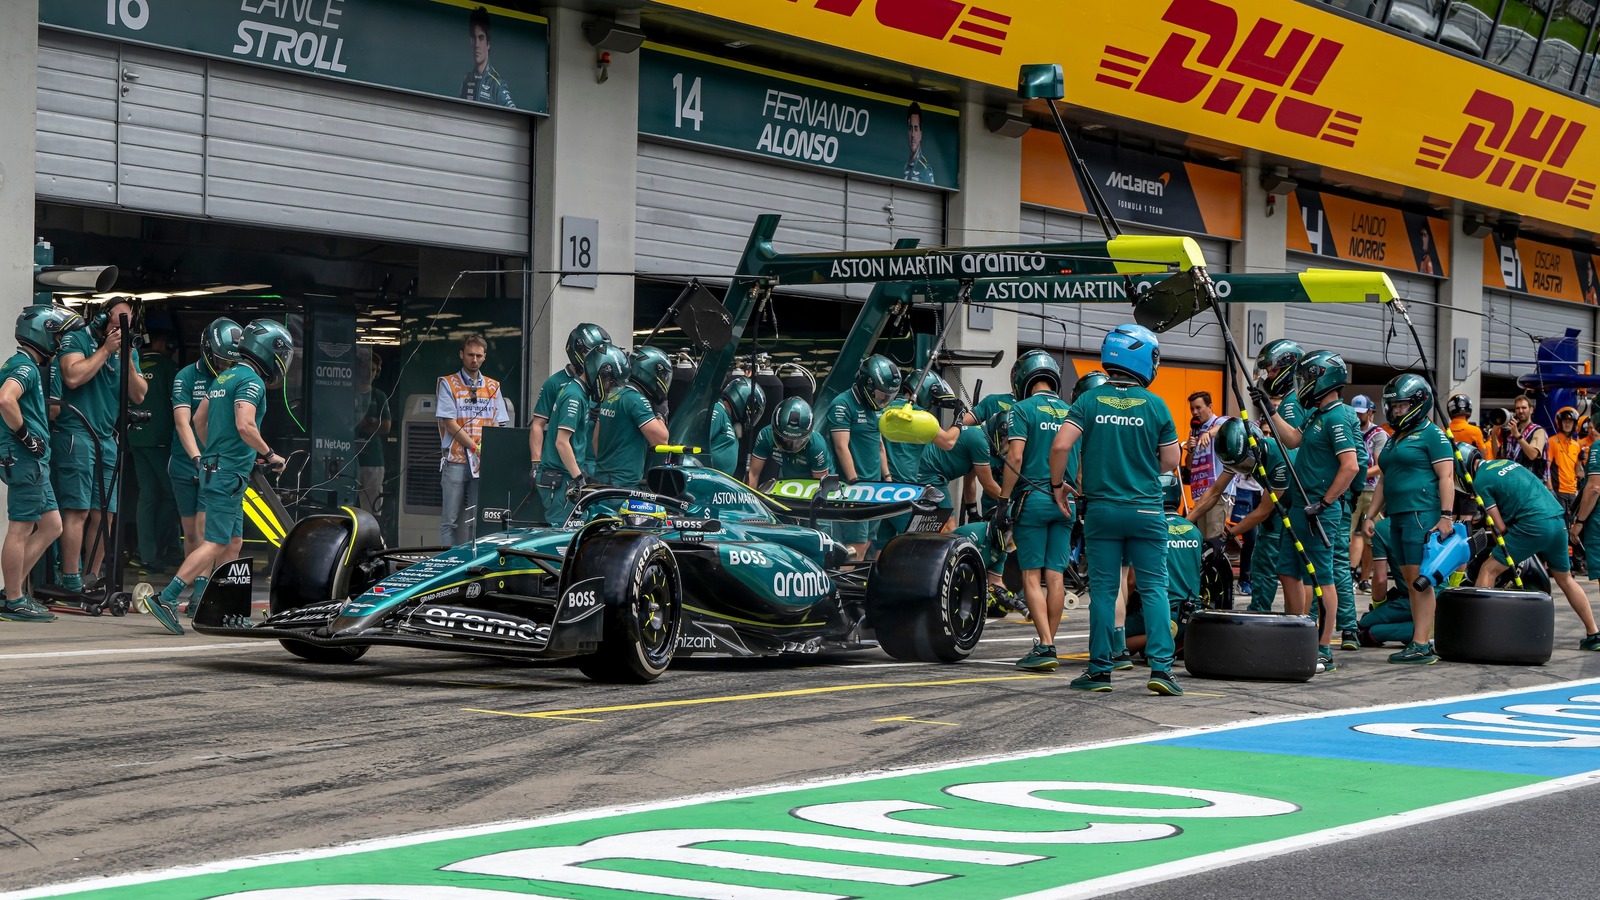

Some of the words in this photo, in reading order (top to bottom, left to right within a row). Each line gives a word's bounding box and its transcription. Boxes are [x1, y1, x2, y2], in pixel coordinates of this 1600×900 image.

[232, 20, 347, 73] STROLL
[1134, 0, 1344, 138] DHL
[672, 73, 704, 131] 14
[762, 89, 870, 137] FERNANDO
[756, 123, 839, 164] ALONSO
[1441, 89, 1587, 204] DHL
[1106, 171, 1164, 197] McLaren
[1118, 200, 1142, 212] FORMULA
[1144, 205, 1148, 213] 1
[1149, 206, 1163, 215] TEAM
[1302, 206, 1324, 255] 4
[1351, 211, 1387, 238] LANDO
[570, 235, 591, 268] 18
[1349, 236, 1387, 261] NORRIS
[830, 258, 885, 278] ASTON
[889, 255, 954, 277] MARTIN
[961, 252, 1046, 274] aramco
[1534, 250, 1561, 272] OSCAR
[985, 281, 1049, 300] ASTON
[1053, 281, 1128, 300] MARTIN
[1532, 271, 1563, 293] PIASTRI
[1252, 323, 1264, 345] 16
[1457, 349, 1466, 368] 15
[316, 366, 352, 378] aramco
[1040, 422, 1062, 431] aram
[1095, 414, 1144, 427] aramco
[324, 439, 351, 452] NetApp
[712, 492, 737, 505] ASTON
[780, 481, 917, 501] armco
[484, 511, 501, 520] BOSS
[631, 503, 654, 511] aramco
[676, 520, 702, 529] BOSS
[1166, 539, 1199, 549] ramco
[728, 550, 767, 565] BOSS
[227, 576, 251, 584] TRADE
[228, 563, 251, 577] AVA
[773, 570, 831, 597] aramco
[568, 591, 596, 608] BOSS
[425, 608, 551, 641] aramco
[677, 633, 717, 648] nizant
